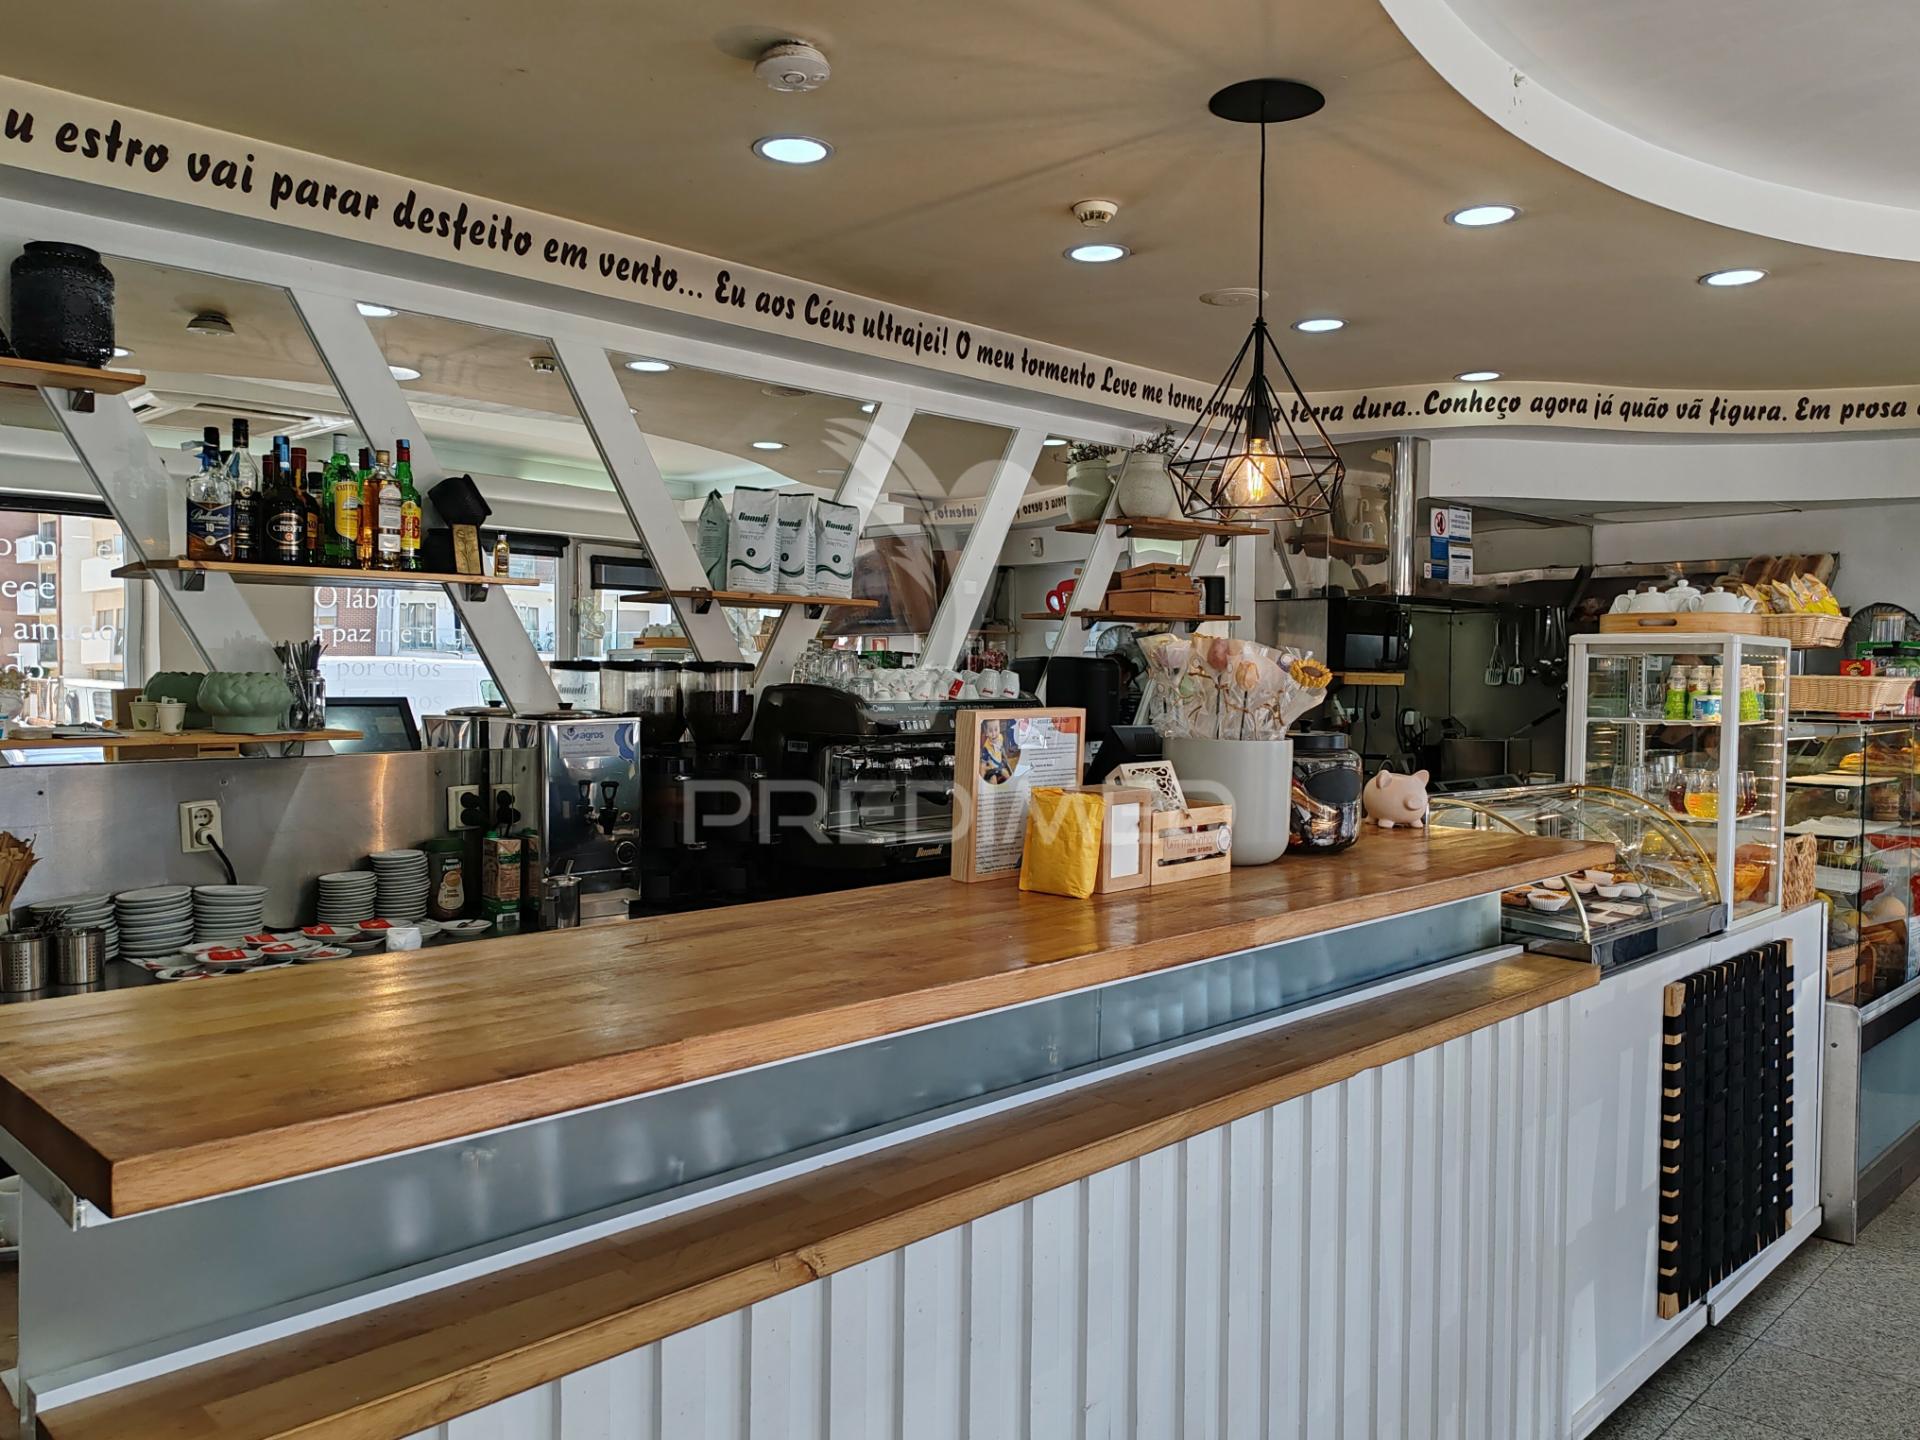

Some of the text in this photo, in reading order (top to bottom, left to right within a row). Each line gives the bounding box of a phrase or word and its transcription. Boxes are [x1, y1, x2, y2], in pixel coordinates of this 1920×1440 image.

[54, 119, 169, 173] estro
[187, 152, 255, 194] vai
[270, 171, 381, 217] parar
[392, 189, 532, 256] desfeito
[543, 238, 588, 270] em
[598, 253, 703, 300] vento...
[714, 268, 748, 306] Eu
[755, 291, 796, 320] aos
[804, 292, 856, 335] Céus
[862, 310, 949, 356] ultrajei!
[955, 330, 972, 360] O
[976, 343, 1015, 371] meu
[1021, 347, 1096, 389] tormento
[1100, 366, 1138, 399] Leve
[1141, 383, 1163, 405] me
[1167, 383, 1203, 413] torne
[1529, 396, 1588, 419] agora
[1593, 393, 1614, 420] já
[1618, 395, 1669, 423] quão
[1675, 397, 1702, 420] vã
[1709, 397, 1787, 427] figura.
[1795, 397, 1831, 420] Em
[1839, 400, 1908, 425] prosa
[333, 628, 371, 647] paz
[337, 662, 376, 680] por
[384, 660, 441, 678] cujos
[579, 731, 605, 742] agros
